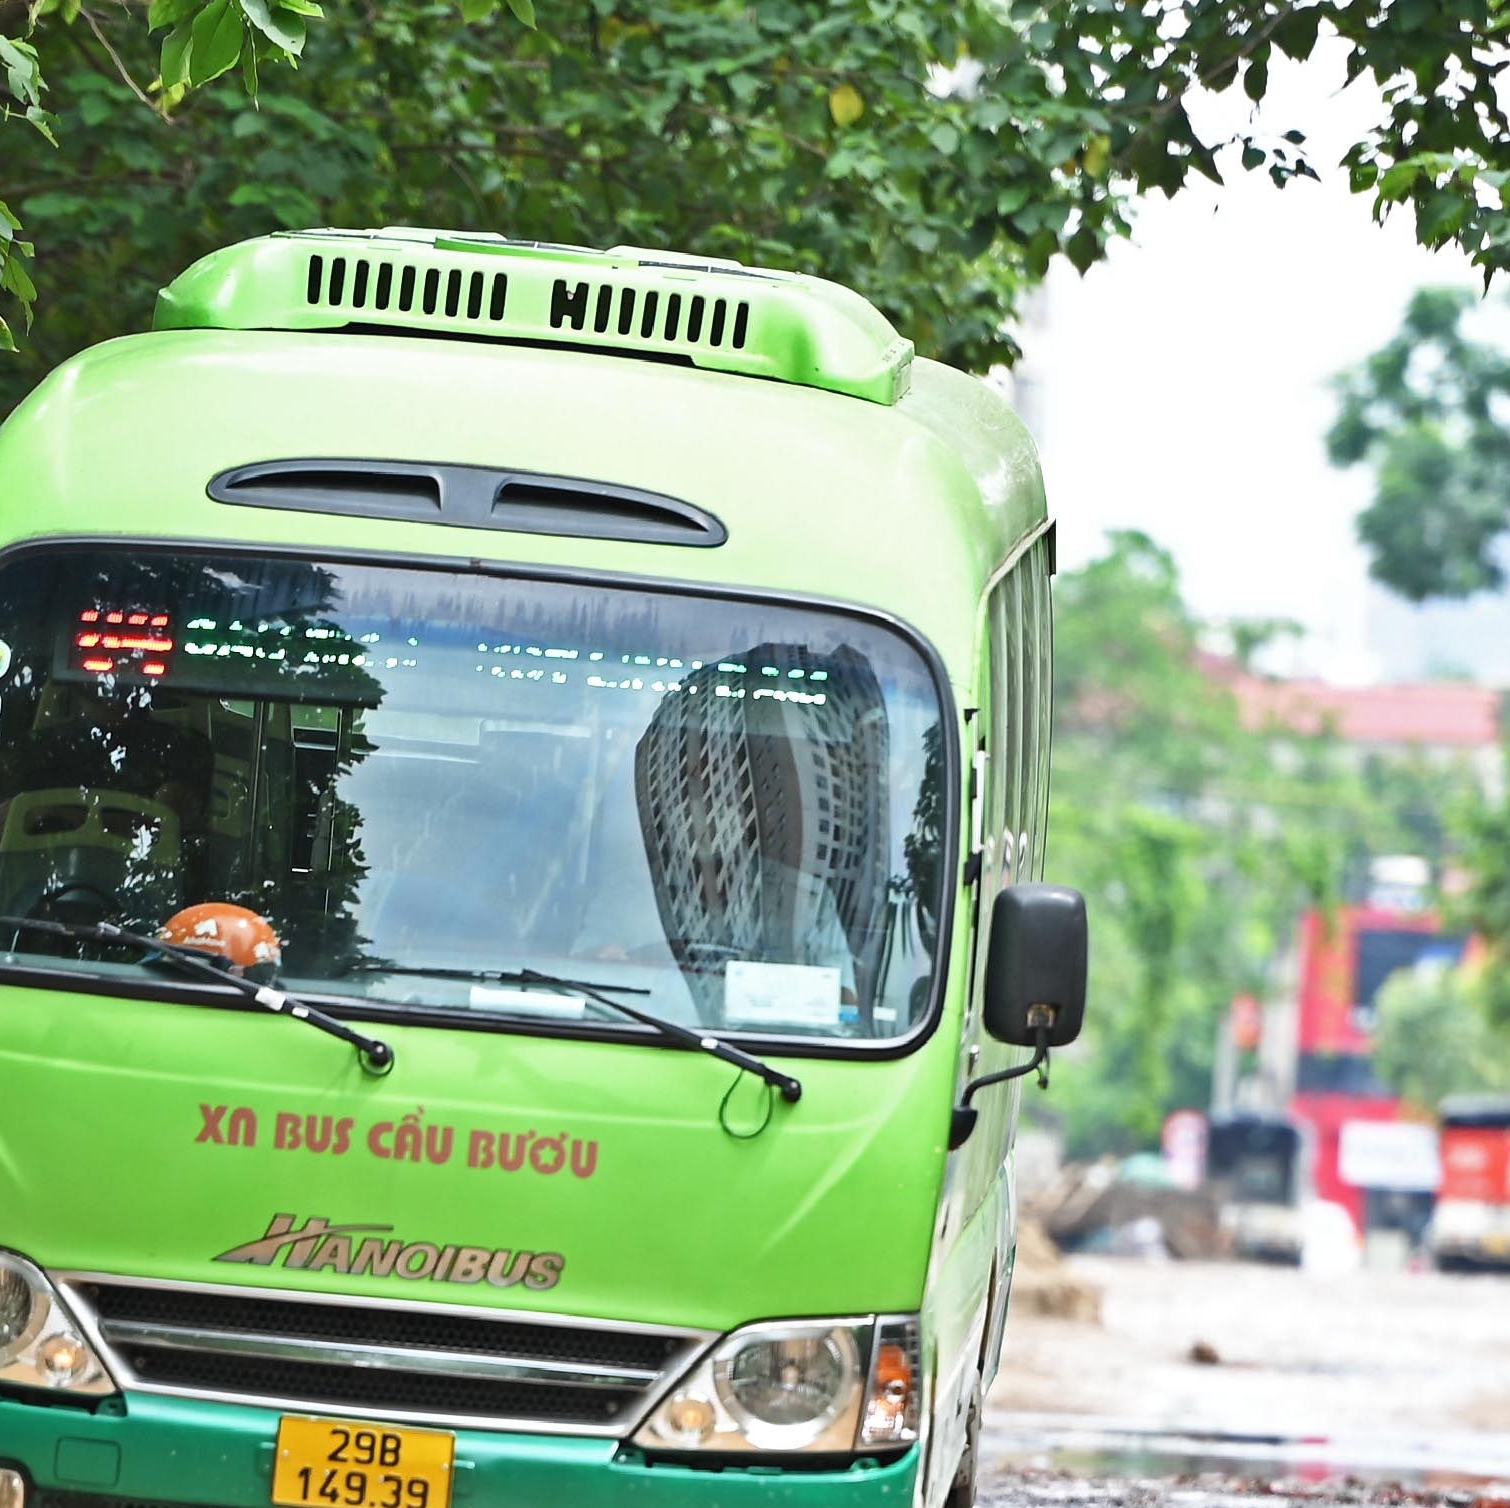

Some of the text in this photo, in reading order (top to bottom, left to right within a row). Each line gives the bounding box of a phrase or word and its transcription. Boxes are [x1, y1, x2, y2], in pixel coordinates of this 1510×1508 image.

[273, 1111, 355, 1155] BUS
[366, 1103, 454, 1165] CẦU
[467, 1128, 599, 1179] BƯƠU
[211, 1212, 566, 1291] HANOIBUS
[327, 1428, 402, 1467] 29B
